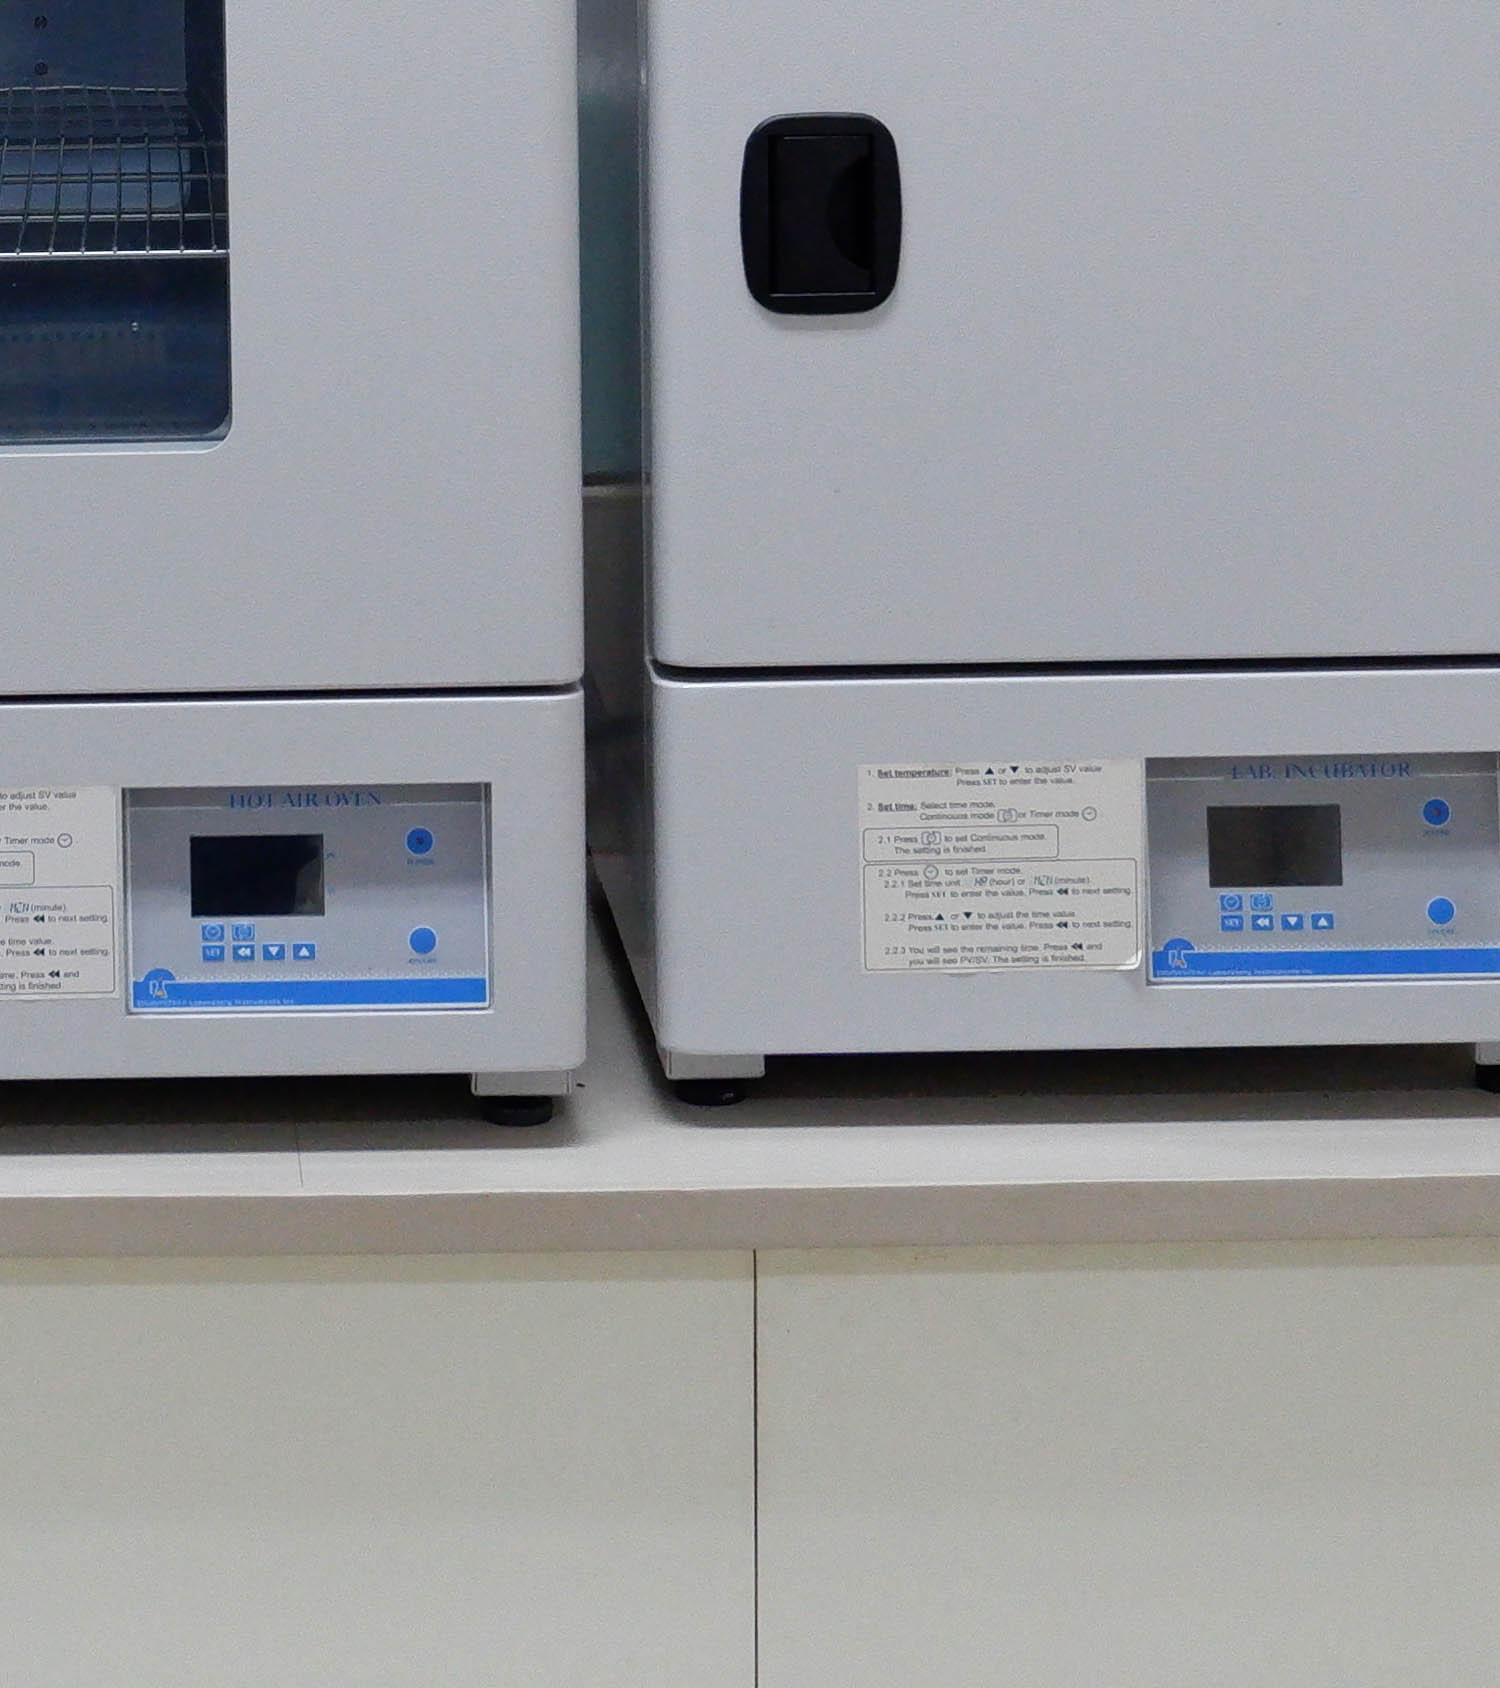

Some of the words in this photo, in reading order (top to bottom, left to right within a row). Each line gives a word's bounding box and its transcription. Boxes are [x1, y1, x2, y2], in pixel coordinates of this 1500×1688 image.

[10, 791, 36, 801] adjust
[281, 791, 319, 808] AIR
[327, 791, 382, 807] OVEN
[9, 803, 22, 811] the
[4, 836, 28, 844] Timer
[31, 836, 55, 844] mode
[944, 835, 953, 843] to
